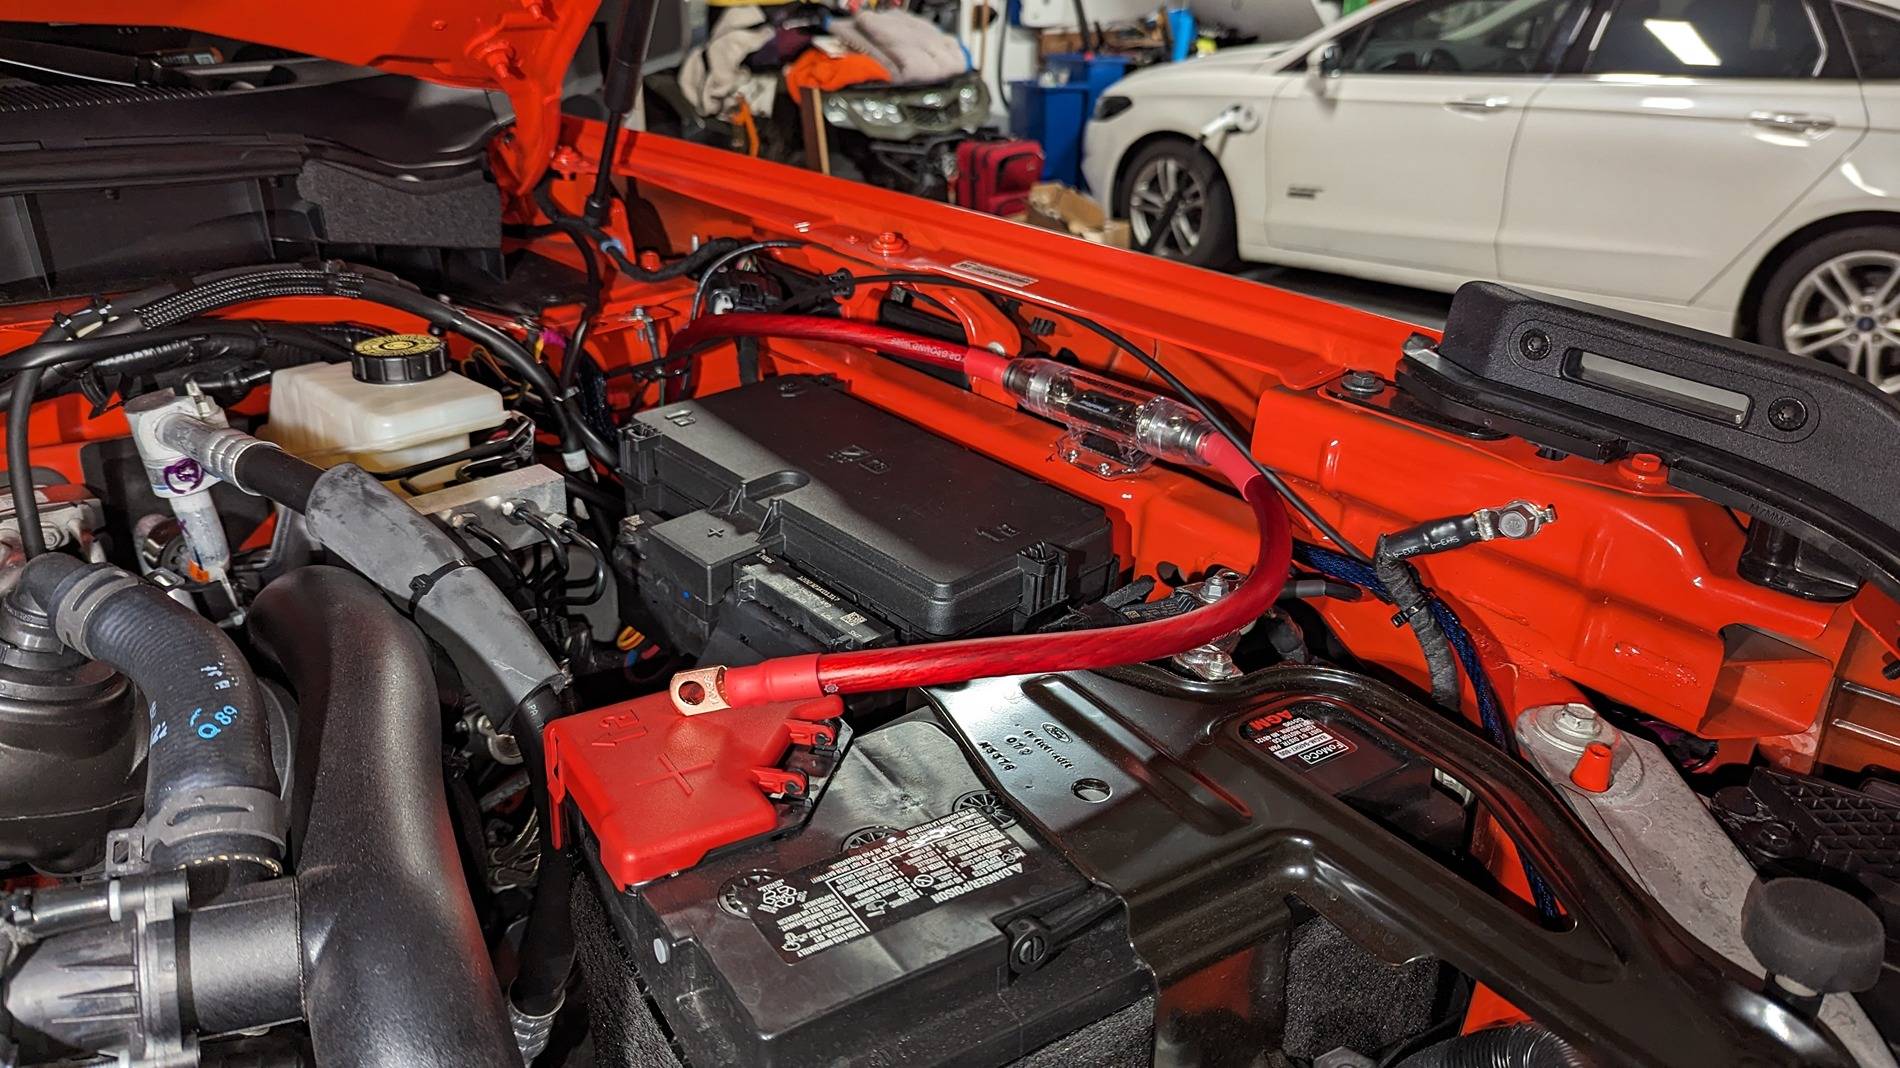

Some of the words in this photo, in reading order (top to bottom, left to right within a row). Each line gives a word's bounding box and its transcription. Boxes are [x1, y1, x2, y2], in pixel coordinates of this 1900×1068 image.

[1249, 710, 1293, 731] AGM
[1304, 741, 1345, 760] FoMoCo
[896, 886, 914, 897] ACID
[930, 866, 1013, 903] DANGER/POISON
